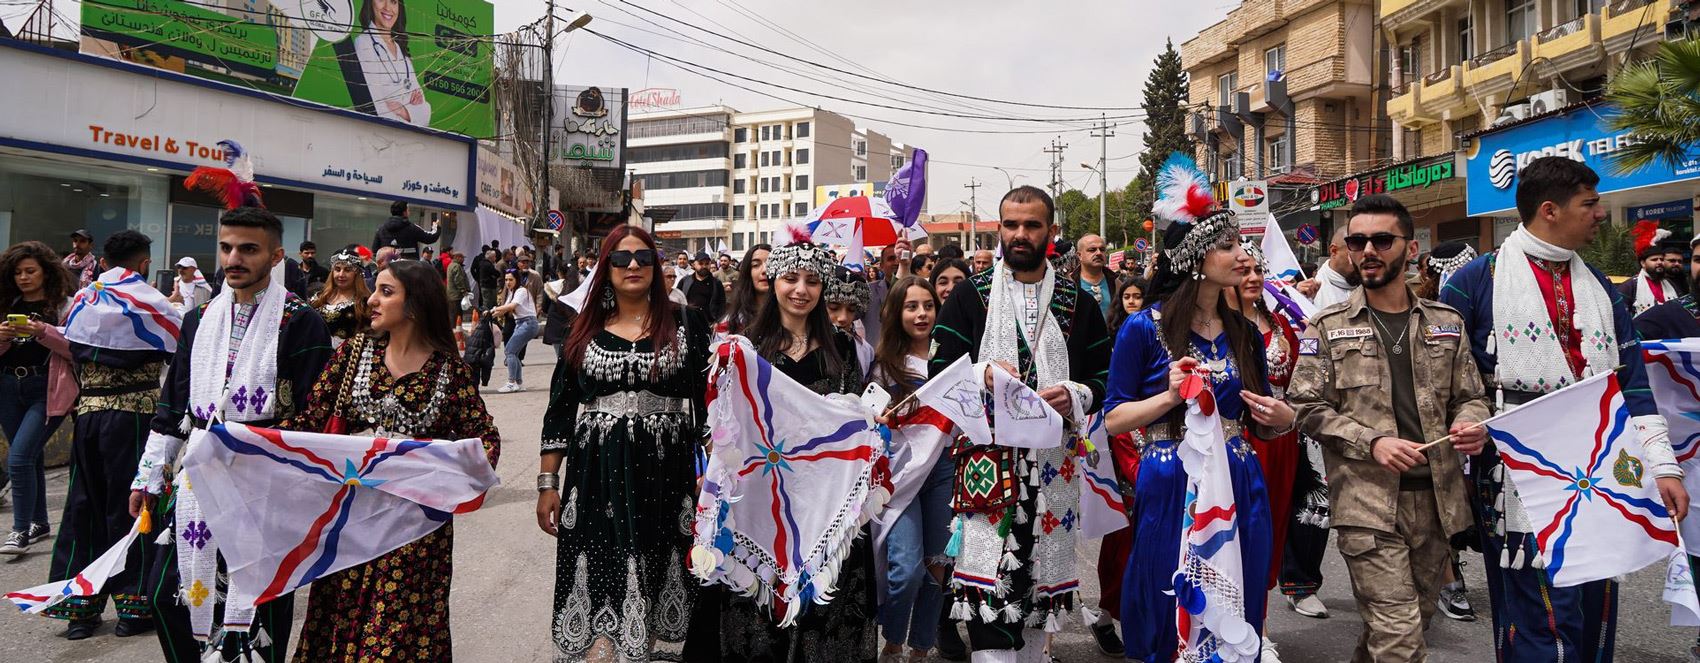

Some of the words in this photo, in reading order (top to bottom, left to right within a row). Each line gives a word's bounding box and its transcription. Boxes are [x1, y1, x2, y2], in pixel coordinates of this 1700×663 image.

[89, 125, 160, 151] Travel
[164, 137, 180, 154] &
[1319, 182, 1341, 202] DIL
[1320, 196, 1346, 211] PHARMACY
[1645, 207, 1665, 216] KOREK
